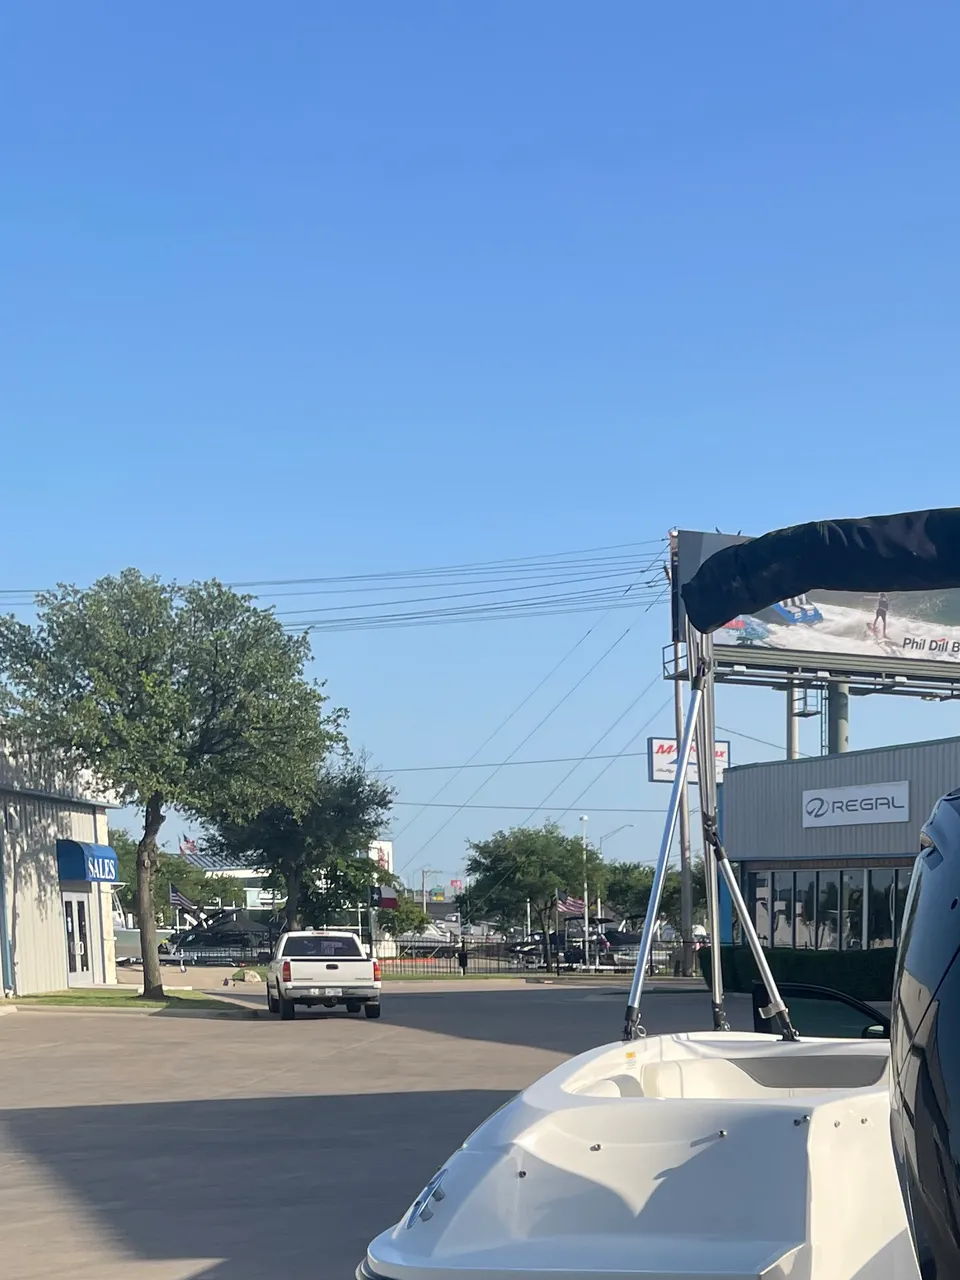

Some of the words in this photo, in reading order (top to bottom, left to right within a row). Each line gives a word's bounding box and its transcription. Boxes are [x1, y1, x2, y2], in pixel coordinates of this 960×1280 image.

[902, 637, 926, 650] Phil
[928, 639, 948, 652] Dill
[832, 795, 905, 813] REGAL
[88, 857, 116, 880] SALES
